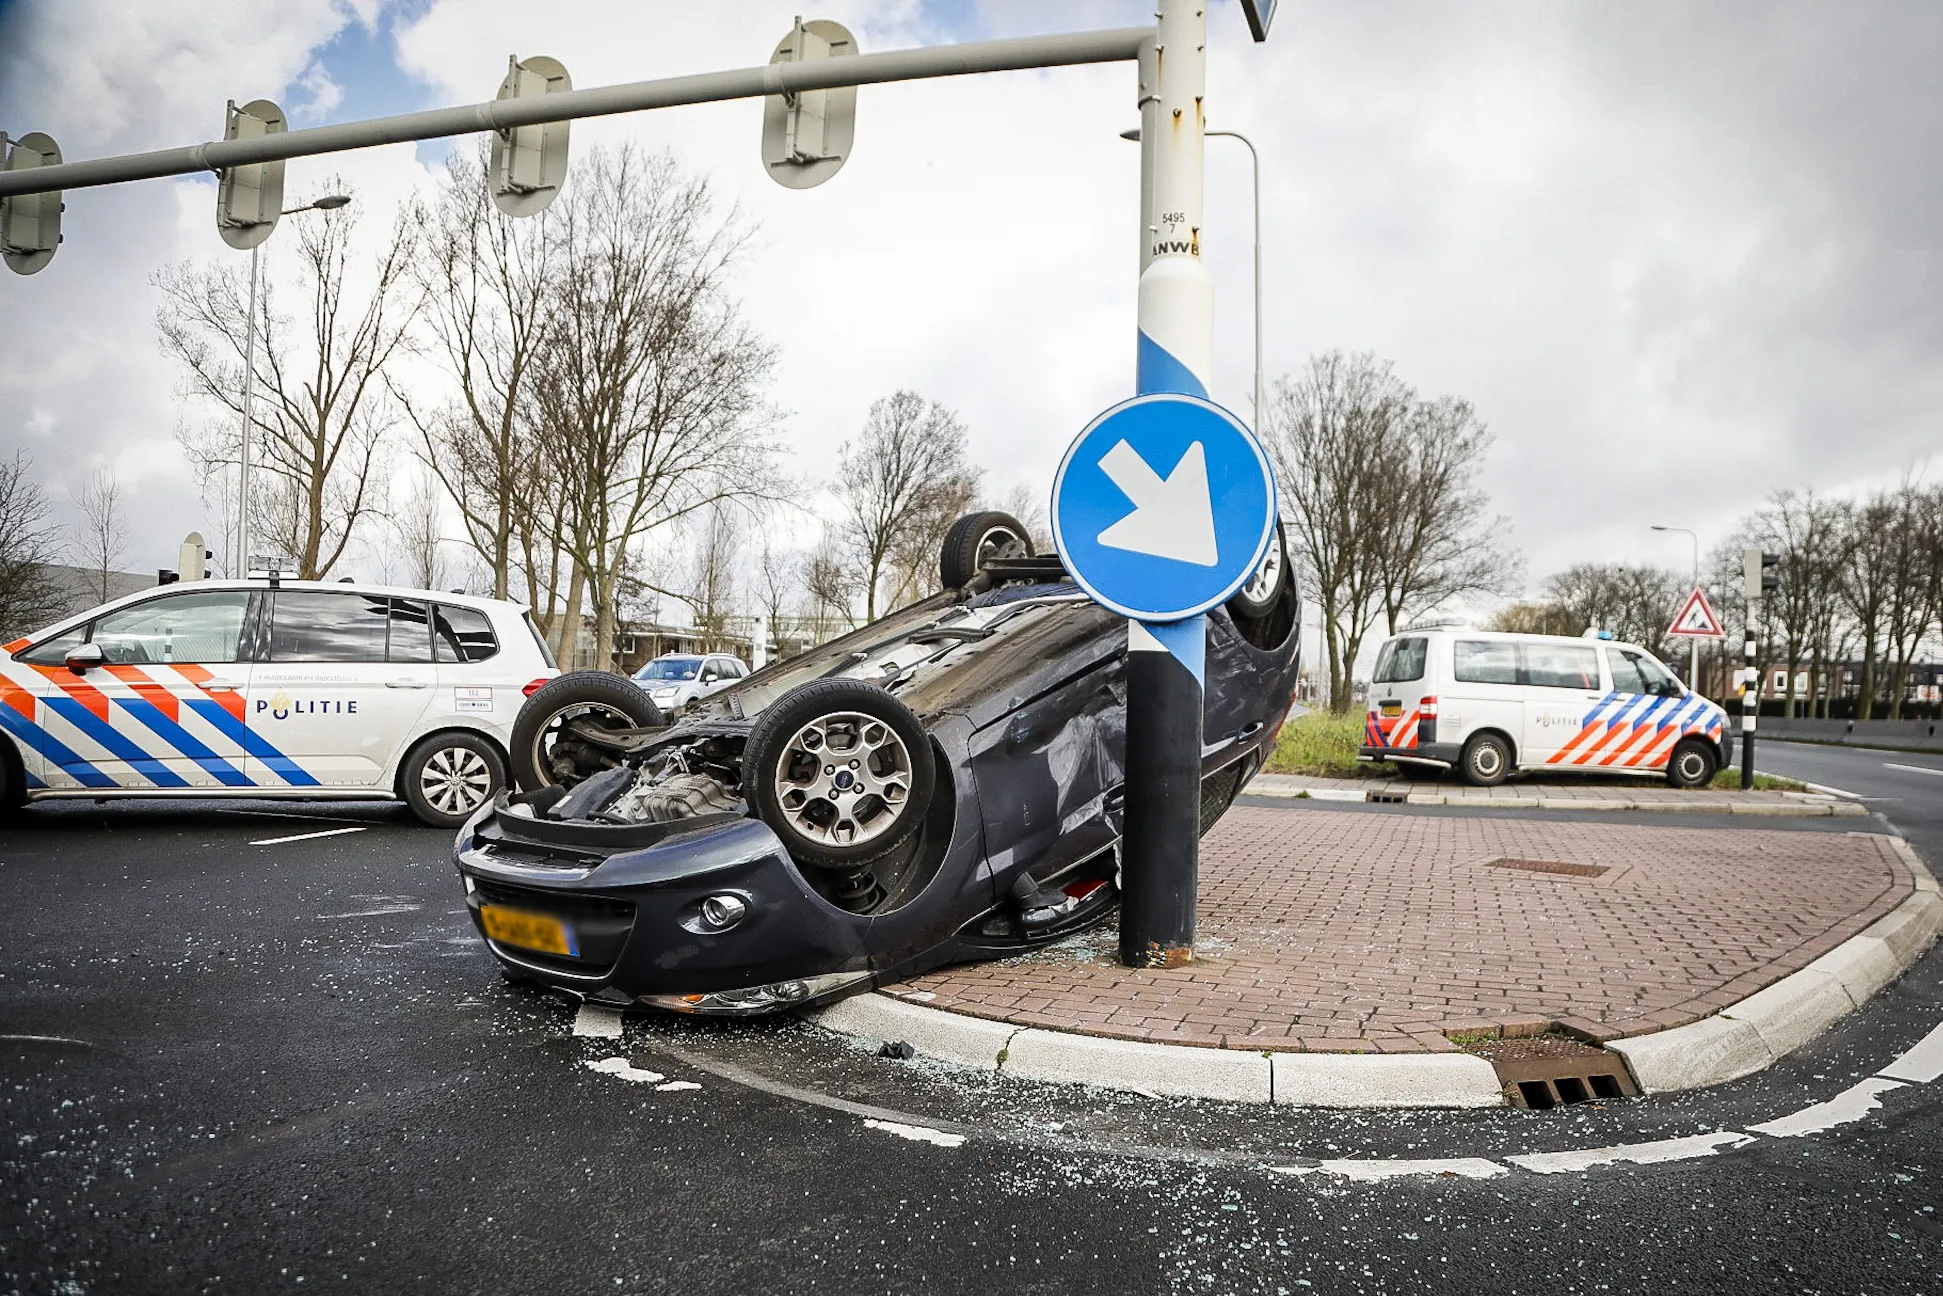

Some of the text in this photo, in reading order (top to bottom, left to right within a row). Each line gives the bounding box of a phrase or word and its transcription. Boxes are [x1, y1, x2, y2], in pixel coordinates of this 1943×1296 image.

[1162, 212, 1185, 223] 5495
[1169, 223, 1175, 233] 7
[1152, 241, 1199, 256] ANWB
[256, 698, 357, 720] POLITIE
